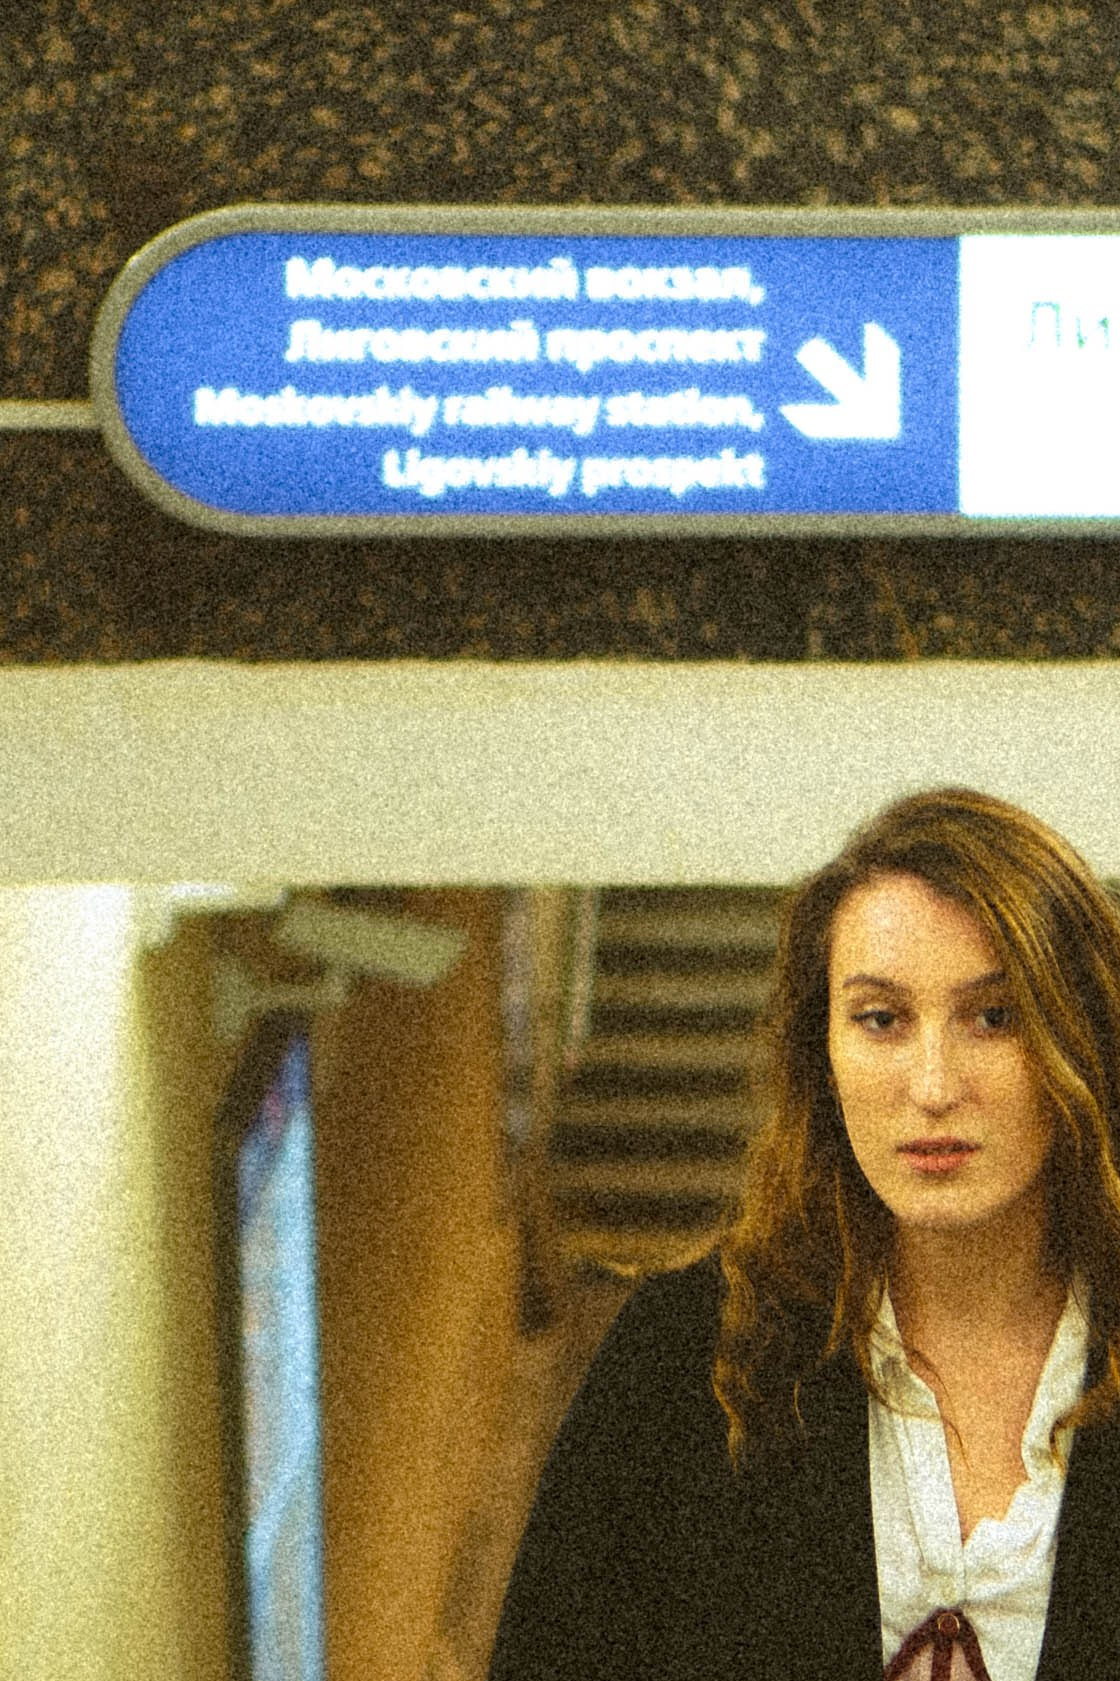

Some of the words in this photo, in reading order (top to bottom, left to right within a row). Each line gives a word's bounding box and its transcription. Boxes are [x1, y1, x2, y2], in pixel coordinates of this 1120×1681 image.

[285, 256, 580, 301] Московский
[284, 319, 541, 363] Лиговский
[545, 327, 768, 373] проспект
[442, 386, 601, 437] railway
